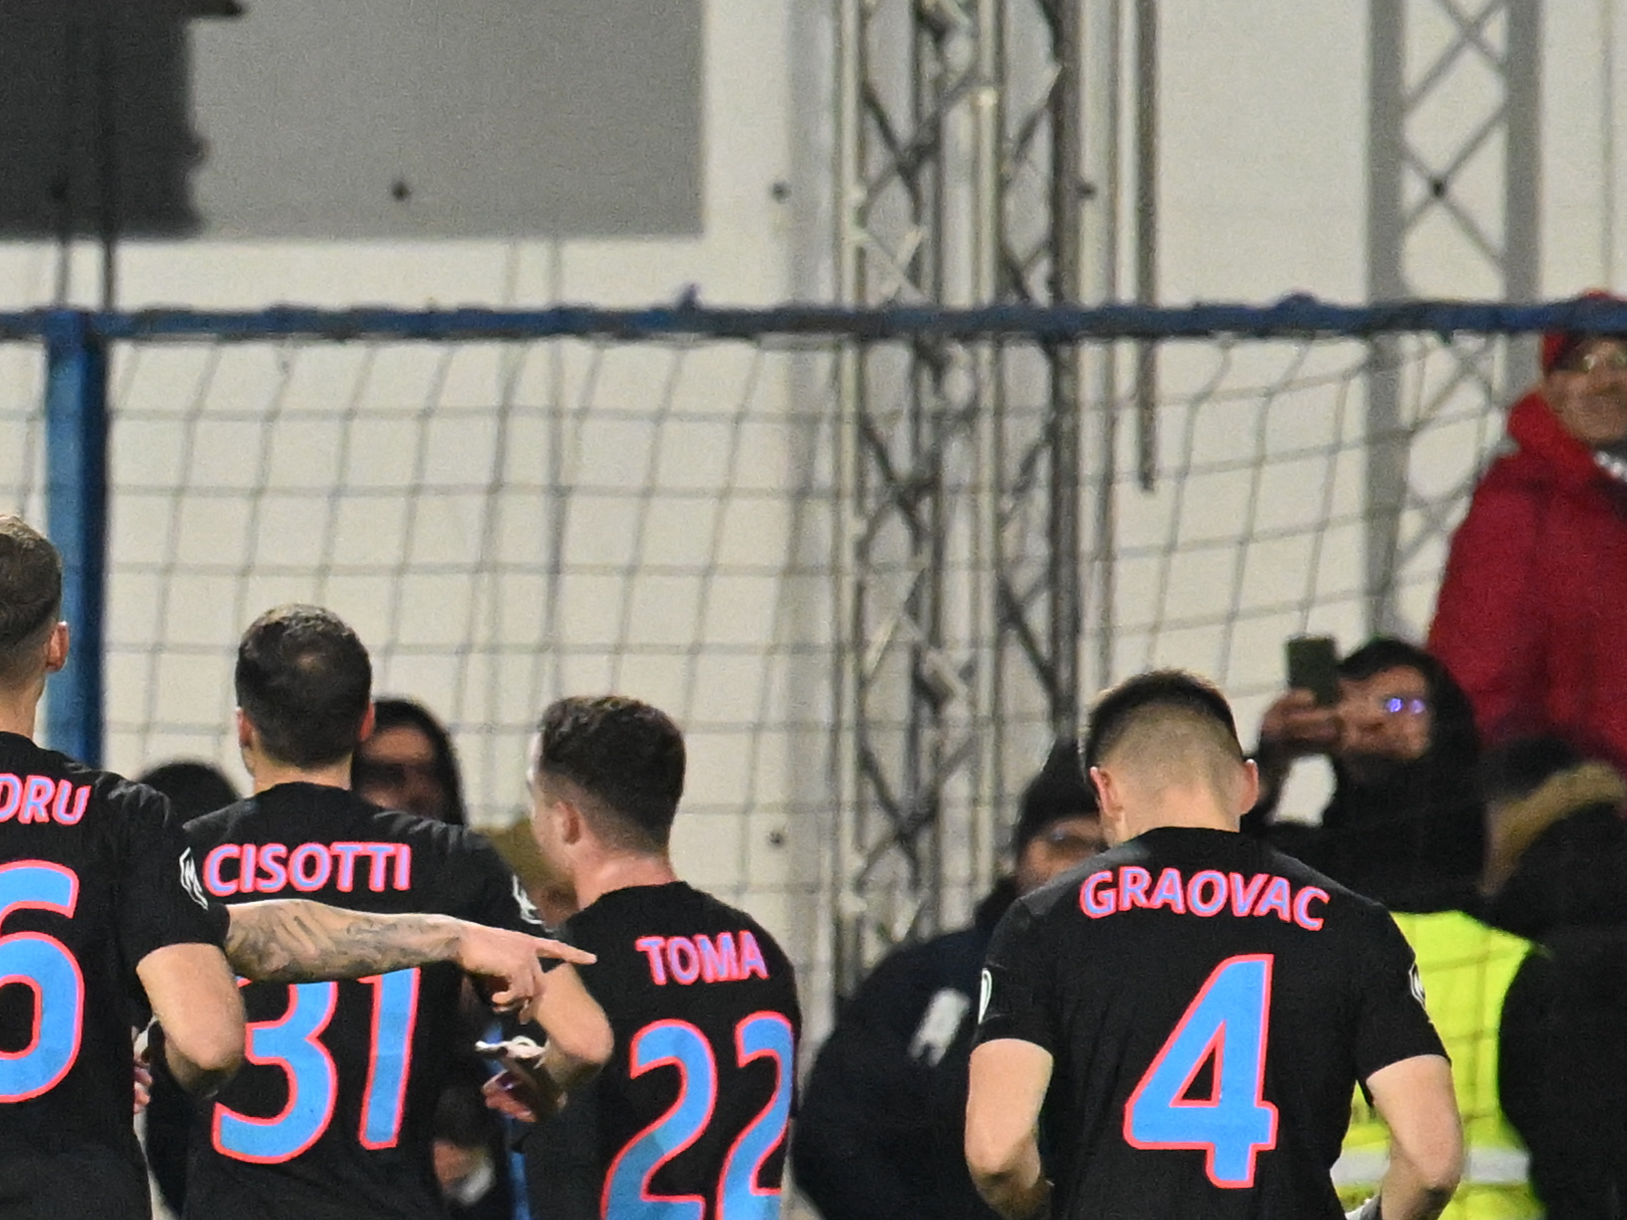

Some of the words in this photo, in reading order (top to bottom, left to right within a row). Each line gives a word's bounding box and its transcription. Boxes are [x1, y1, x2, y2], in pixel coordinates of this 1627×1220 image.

[202, 842, 412, 897] CISOTTI
[1079, 865, 1331, 931] GRAOVAC
[634, 930, 770, 986] TOMA
[211, 966, 422, 1165] 31
[1123, 953, 1279, 1189] 4
